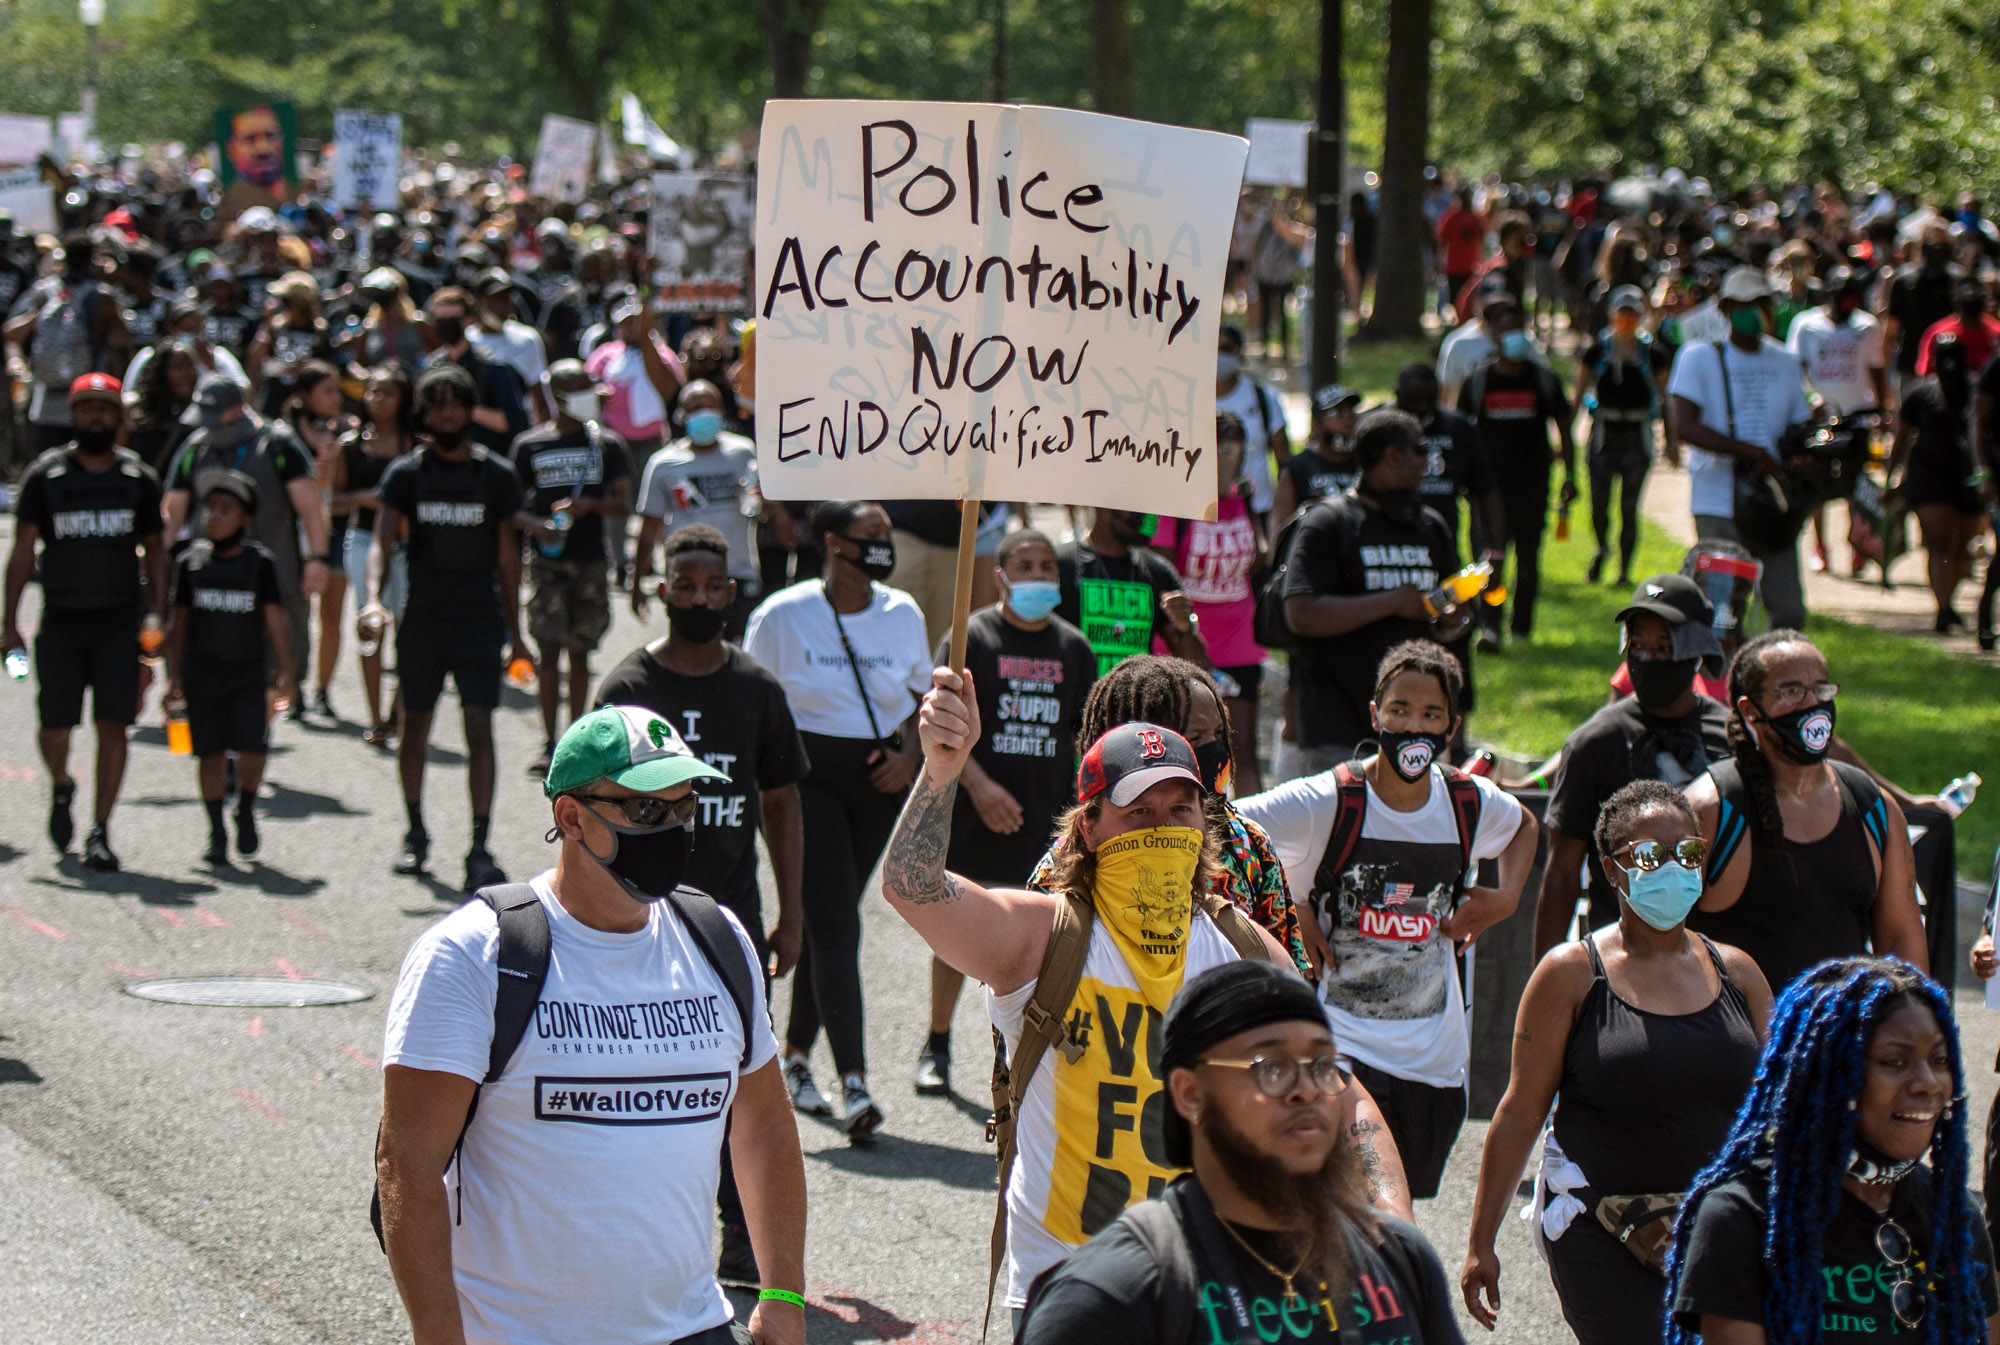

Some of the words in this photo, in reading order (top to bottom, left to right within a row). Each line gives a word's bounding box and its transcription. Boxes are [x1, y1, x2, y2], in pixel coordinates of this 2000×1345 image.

[861, 119, 1110, 233] Police
[911, 326, 1090, 396] NOW
[777, 397, 889, 463] END
[899, 398, 1074, 469] Qualified
[1082, 409, 1202, 483] Immunity
[1359, 545, 1433, 567] BLACK
[997, 654, 1064, 684] NURSES
[682, 709, 702, 742] I
[991, 732, 1044, 757] SEDATE
[1044, 737, 1058, 758] IT
[1137, 729, 1166, 760] B
[698, 793, 747, 828] THE
[1098, 838, 1140, 860] ommon
[1143, 834, 1188, 851] Ground
[1362, 908, 1433, 938] NASA
[644, 1041, 680, 1055] YOUR
[547, 1087, 724, 1113] #WallOfVets
[1197, 1272, 1404, 1345] fee-ish
[1820, 1312, 1878, 1333] une
